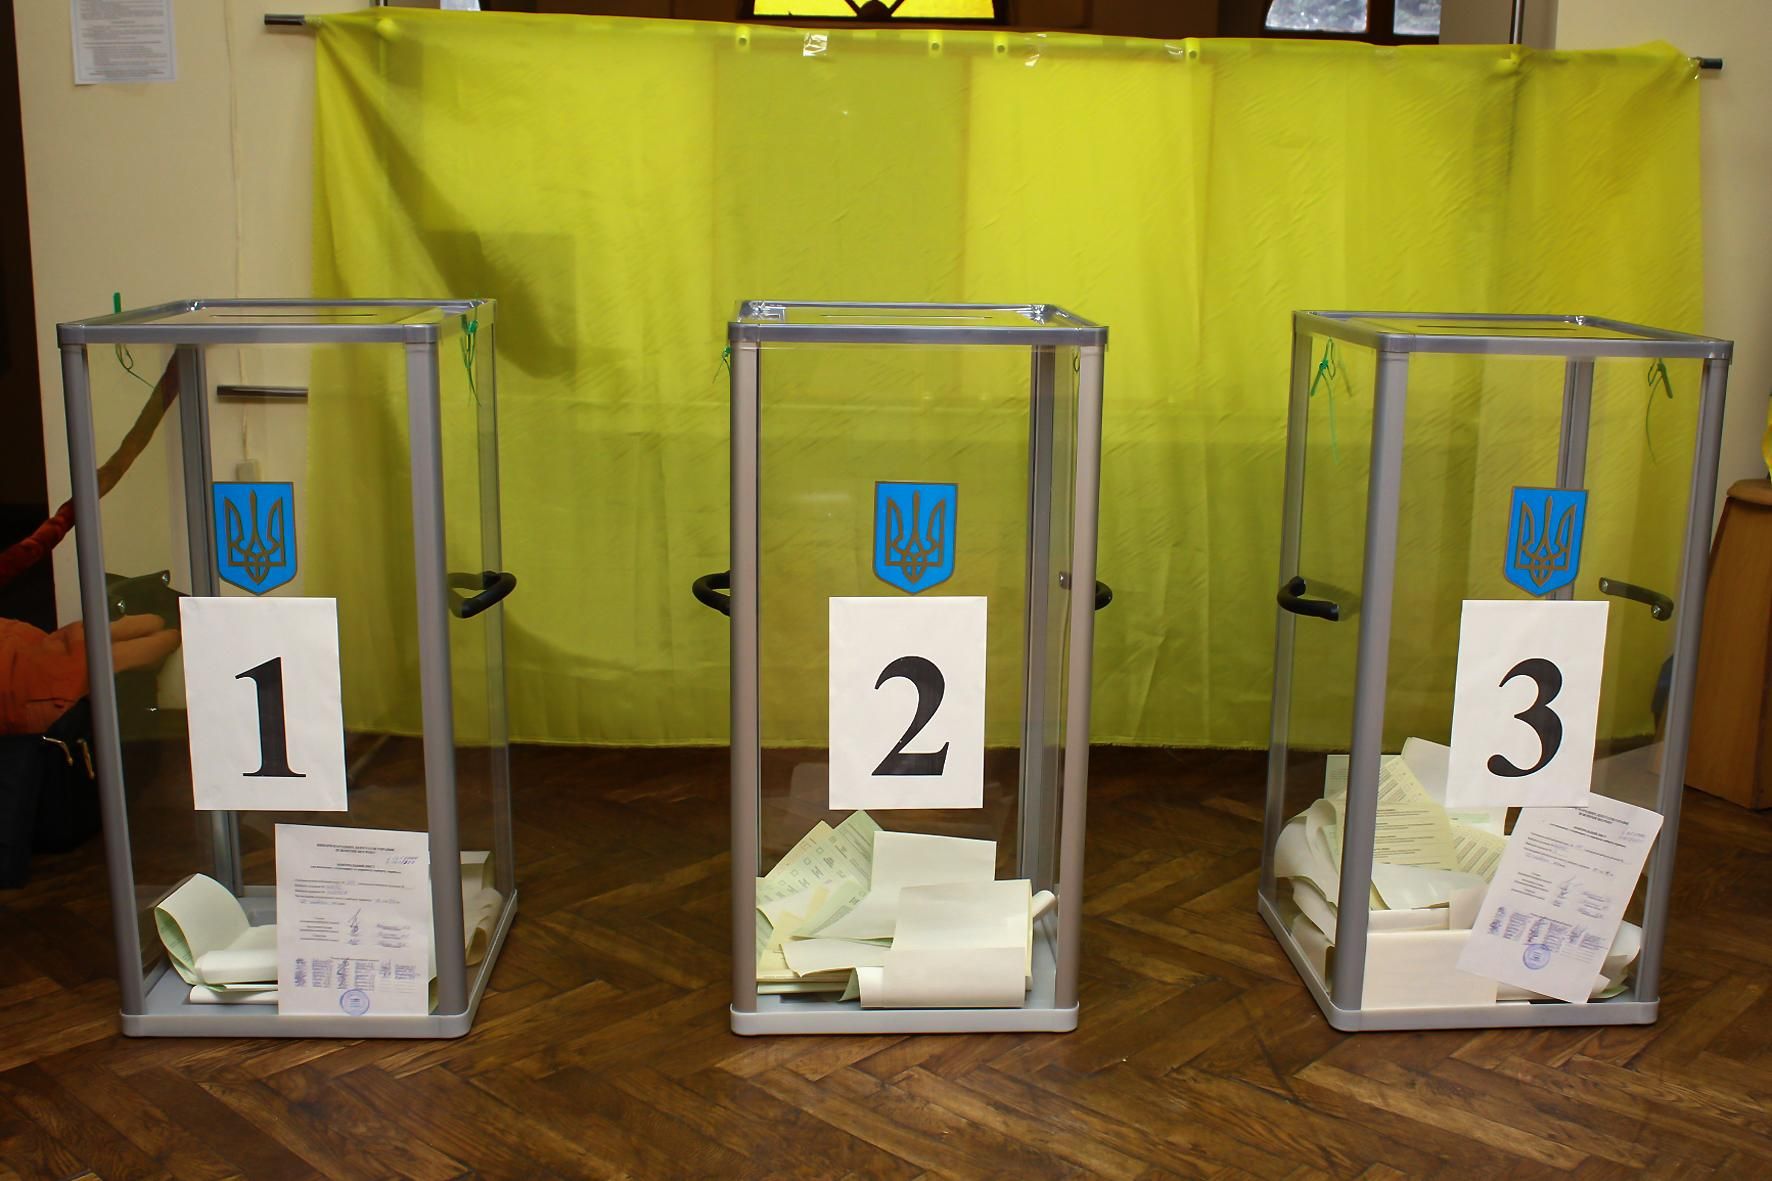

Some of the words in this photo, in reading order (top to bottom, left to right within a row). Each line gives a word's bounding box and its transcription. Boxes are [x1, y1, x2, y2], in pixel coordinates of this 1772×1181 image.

[235, 657, 307, 778] 1
[872, 656, 950, 776] 2
[1487, 658, 1563, 778] 3
